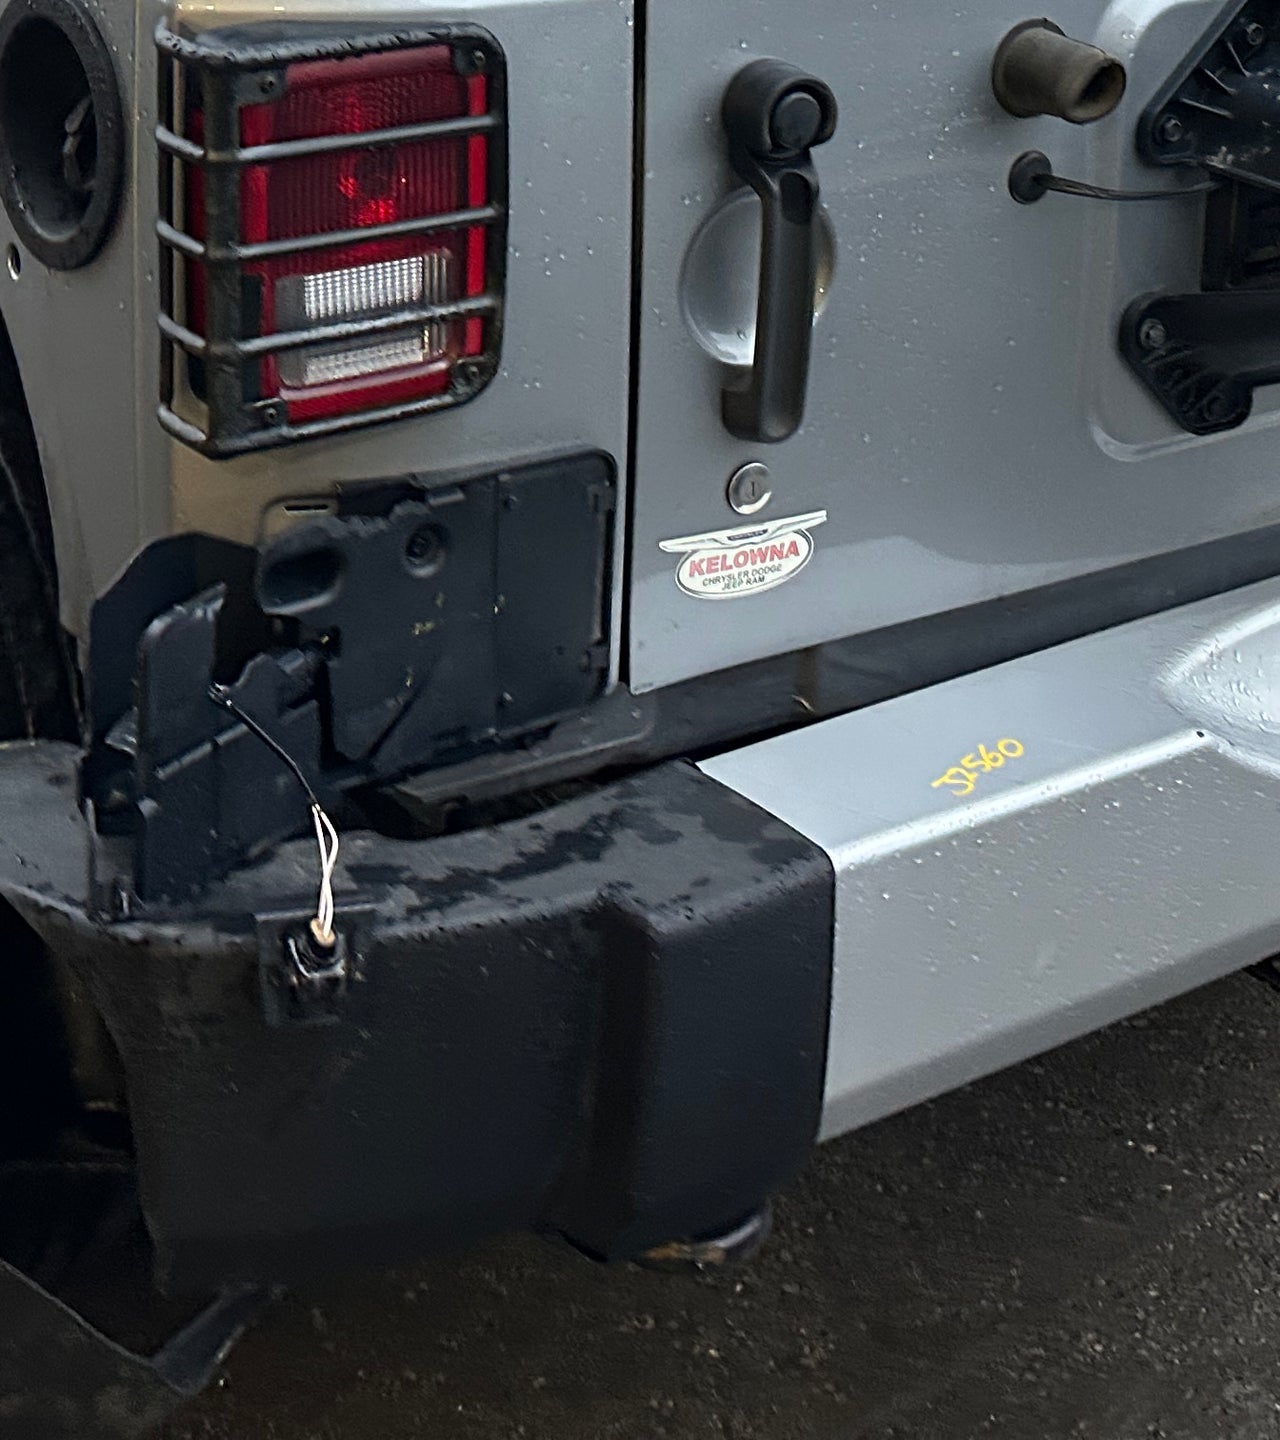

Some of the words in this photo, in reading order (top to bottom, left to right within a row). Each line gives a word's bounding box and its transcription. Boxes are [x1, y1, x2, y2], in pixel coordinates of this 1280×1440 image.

[688, 540, 800, 578] KELOWNA
[702, 570, 749, 587] CHRYSLER
[751, 563, 783, 577] DODGE
[721, 578, 744, 591] JEEP
[746, 575, 765, 586] RAM
[930, 738, 1025, 796] J2560
